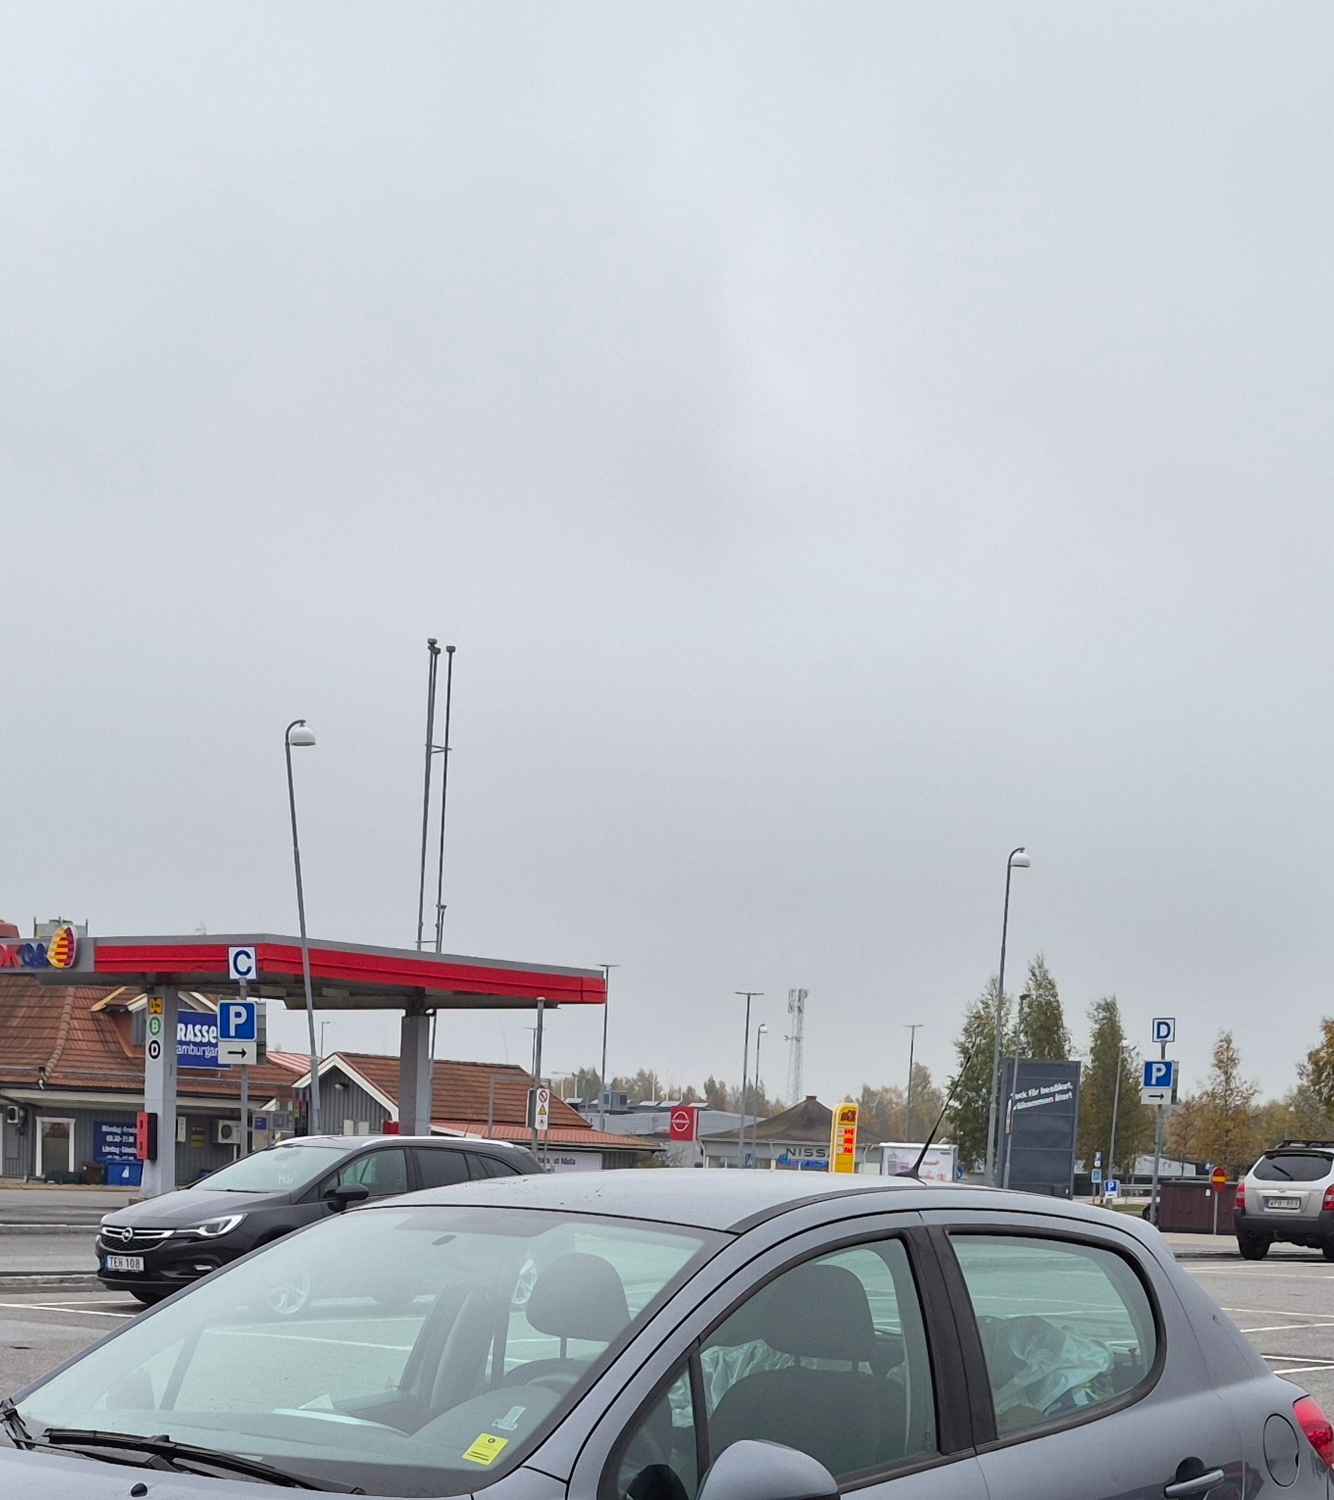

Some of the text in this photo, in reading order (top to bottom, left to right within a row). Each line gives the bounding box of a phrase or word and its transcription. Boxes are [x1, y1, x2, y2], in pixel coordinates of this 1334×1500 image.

[233, 950, 252, 976] C
[229, 1005, 247, 1037] P
[1157, 1021, 1170, 1039] D
[177, 1023, 217, 1043] RASSe
[151, 1044, 158, 1056] D
[176, 1043, 218, 1058] amburgar
[1151, 1063, 1166, 1085] P
[786, 1148, 830, 1157] NISS
[109, 1257, 140, 1268] TEH 108
